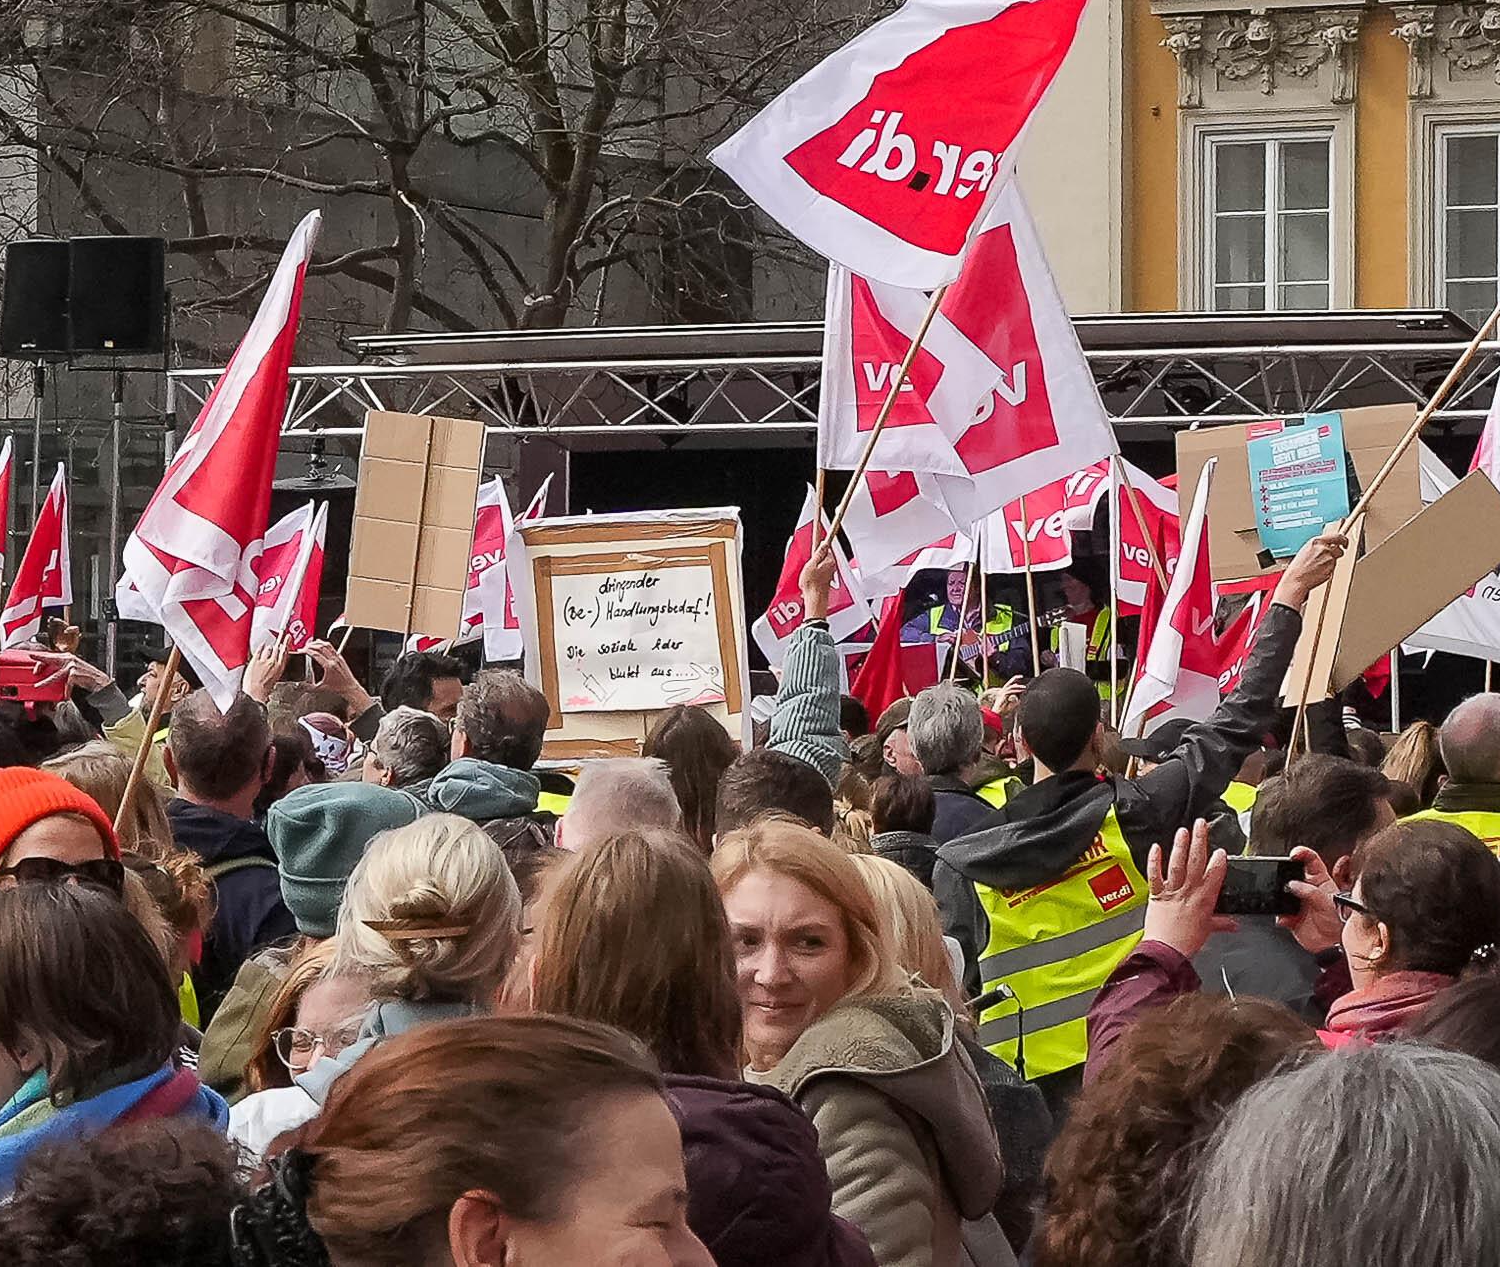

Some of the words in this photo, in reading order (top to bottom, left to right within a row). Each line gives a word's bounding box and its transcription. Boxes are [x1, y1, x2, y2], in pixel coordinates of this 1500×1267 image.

[598, 572, 661, 602] dringender
[566, 645, 586, 659] Die
[597, 638, 638, 655] soziale
[610, 665, 640, 680] blutet
[1099, 886, 1132, 904] ver.di
